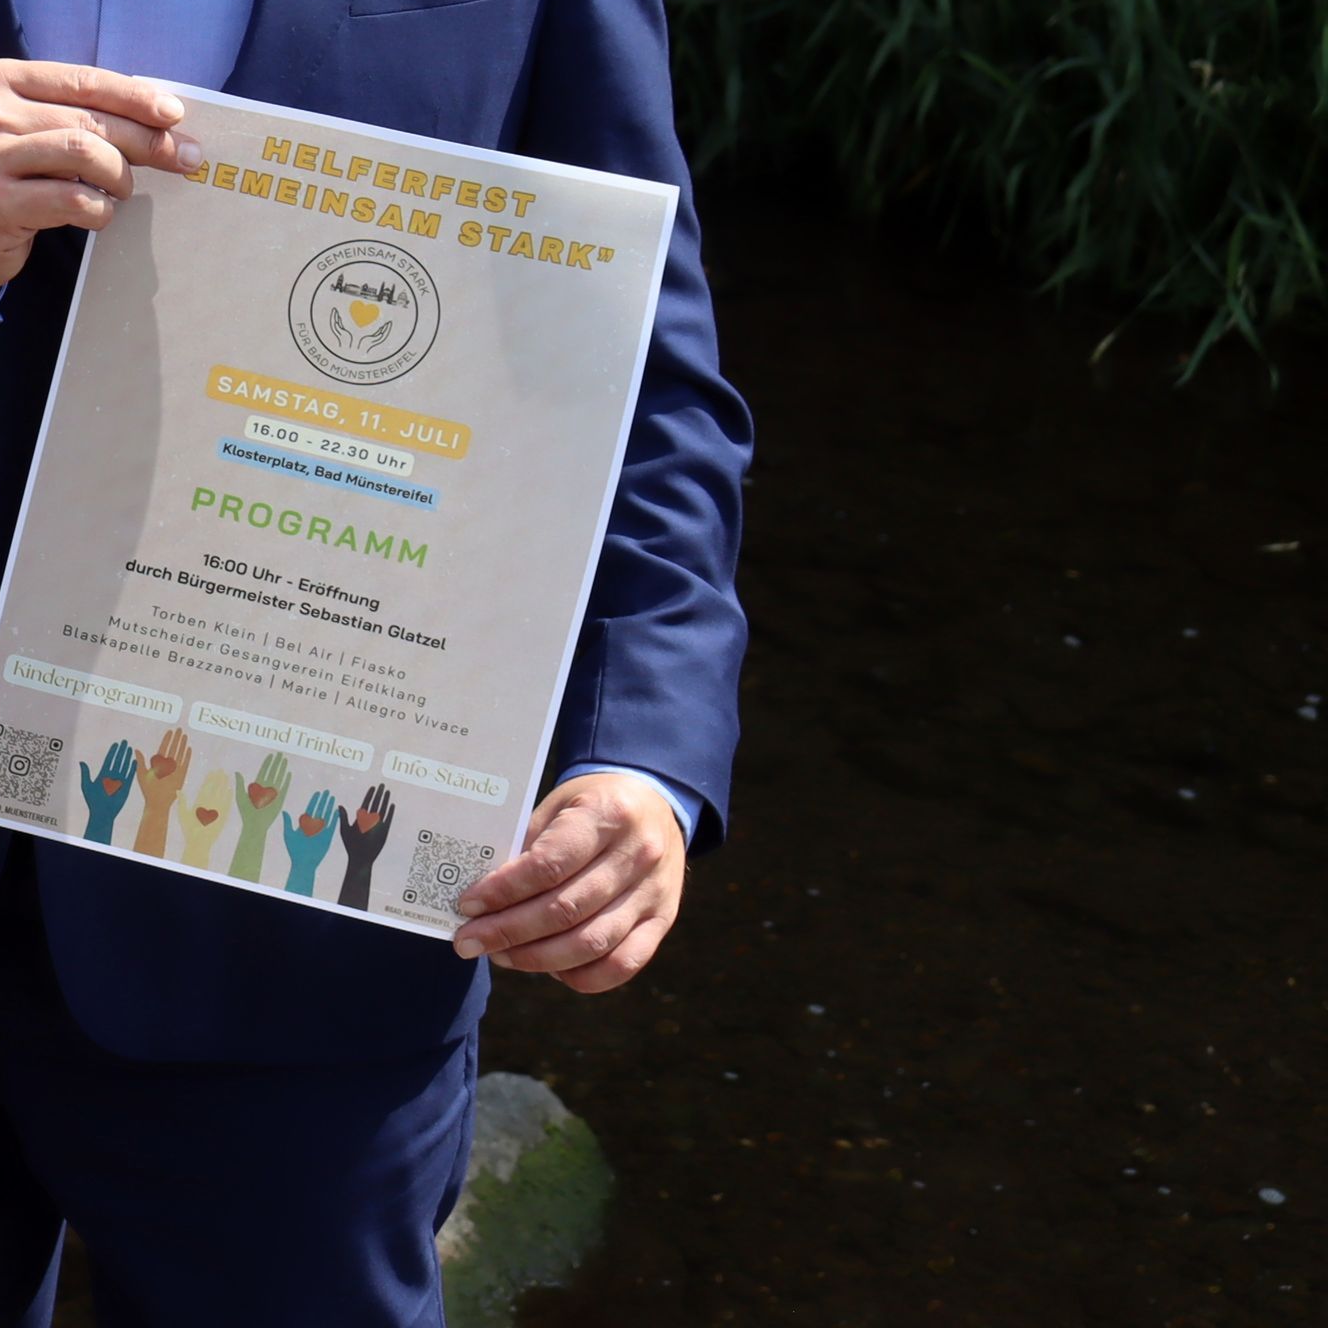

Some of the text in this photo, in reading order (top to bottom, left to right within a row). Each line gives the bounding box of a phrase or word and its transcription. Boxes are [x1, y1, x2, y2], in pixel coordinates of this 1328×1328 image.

[262, 136, 536, 218] HELFERFEST
[316, 246, 430, 296] GEMEINSAM STARK
[458, 220, 614, 270] STARK”
[296, 322, 417, 380] FÜR BAD MÜNSTEREIFEL
[217, 375, 459, 449] SAMSTAG, 11. JULI
[221, 442, 433, 504] Klosterplatz, Bad Münstereifel
[252, 422, 299, 443] 16.00
[319, 438, 369, 460] 22.30
[376, 452, 407, 469] Uhr
[190, 486, 428, 568] PROGRAMM
[124, 559, 446, 650] durch Bürgermeister Sebastian Glatzel
[203, 553, 248, 575] 16:00
[251, 565, 282, 584] Uhr
[297, 577, 380, 612] Eröffnung
[107, 614, 427, 708] Mutscheider Gesangverein Eifelklang
[151, 605, 406, 680] Torben Klein Bel Air Fiasko
[13, 660, 173, 714] Kinderprogramm
[61, 623, 469, 736] Blaskapelle Brazzanova Marie Allegro Vivace
[197, 706, 364, 762] Essen und Trinken
[391, 755, 499, 796] Info Stände
